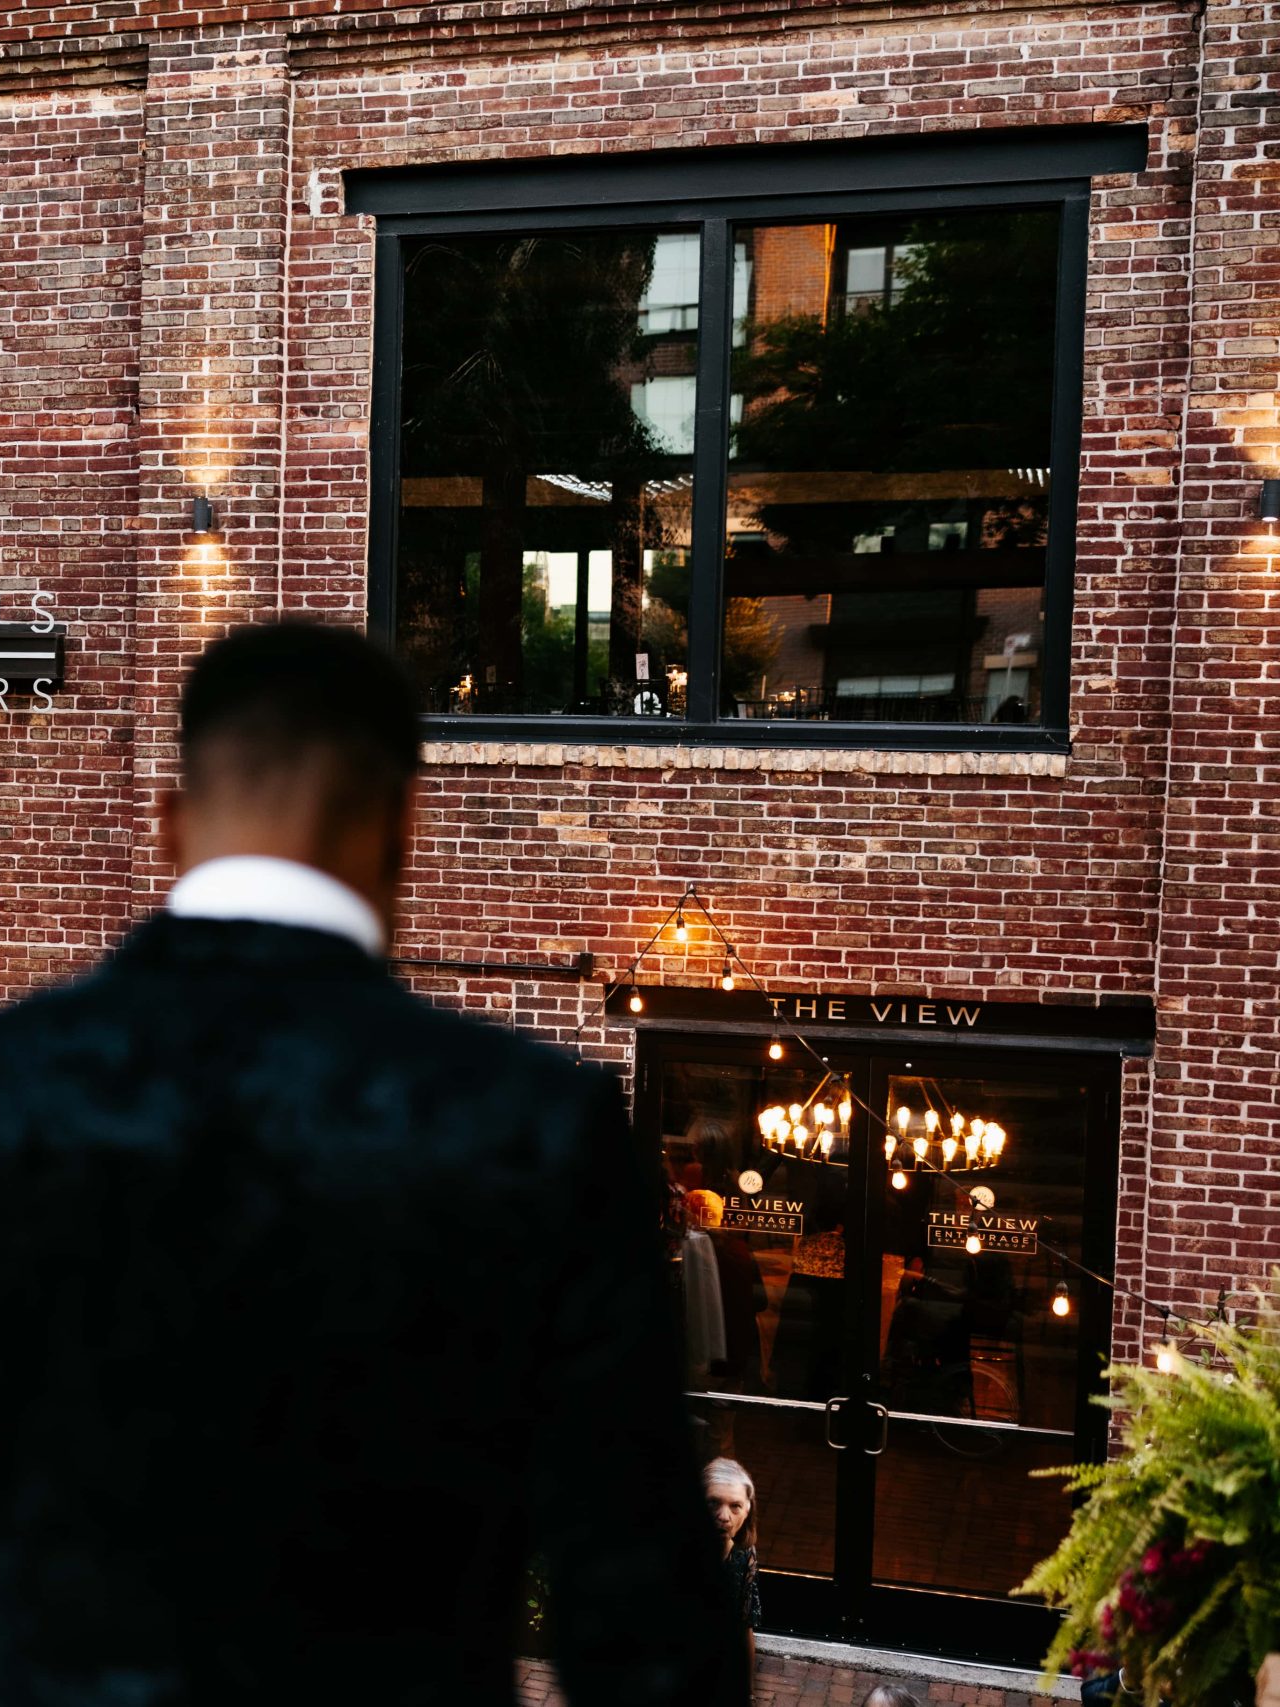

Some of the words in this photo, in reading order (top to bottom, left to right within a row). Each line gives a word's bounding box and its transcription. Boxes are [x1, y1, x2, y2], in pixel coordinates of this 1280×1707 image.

[769, 998, 846, 1020] THE
[870, 1003, 980, 1026] VIEW
[751, 1198, 803, 1213] VIEW
[707, 1211, 796, 1226] ETOURAGE
[929, 1212, 970, 1226] THE
[981, 1216, 1037, 1231] VIEW
[935, 1230, 1029, 1244] ENTURAGE
